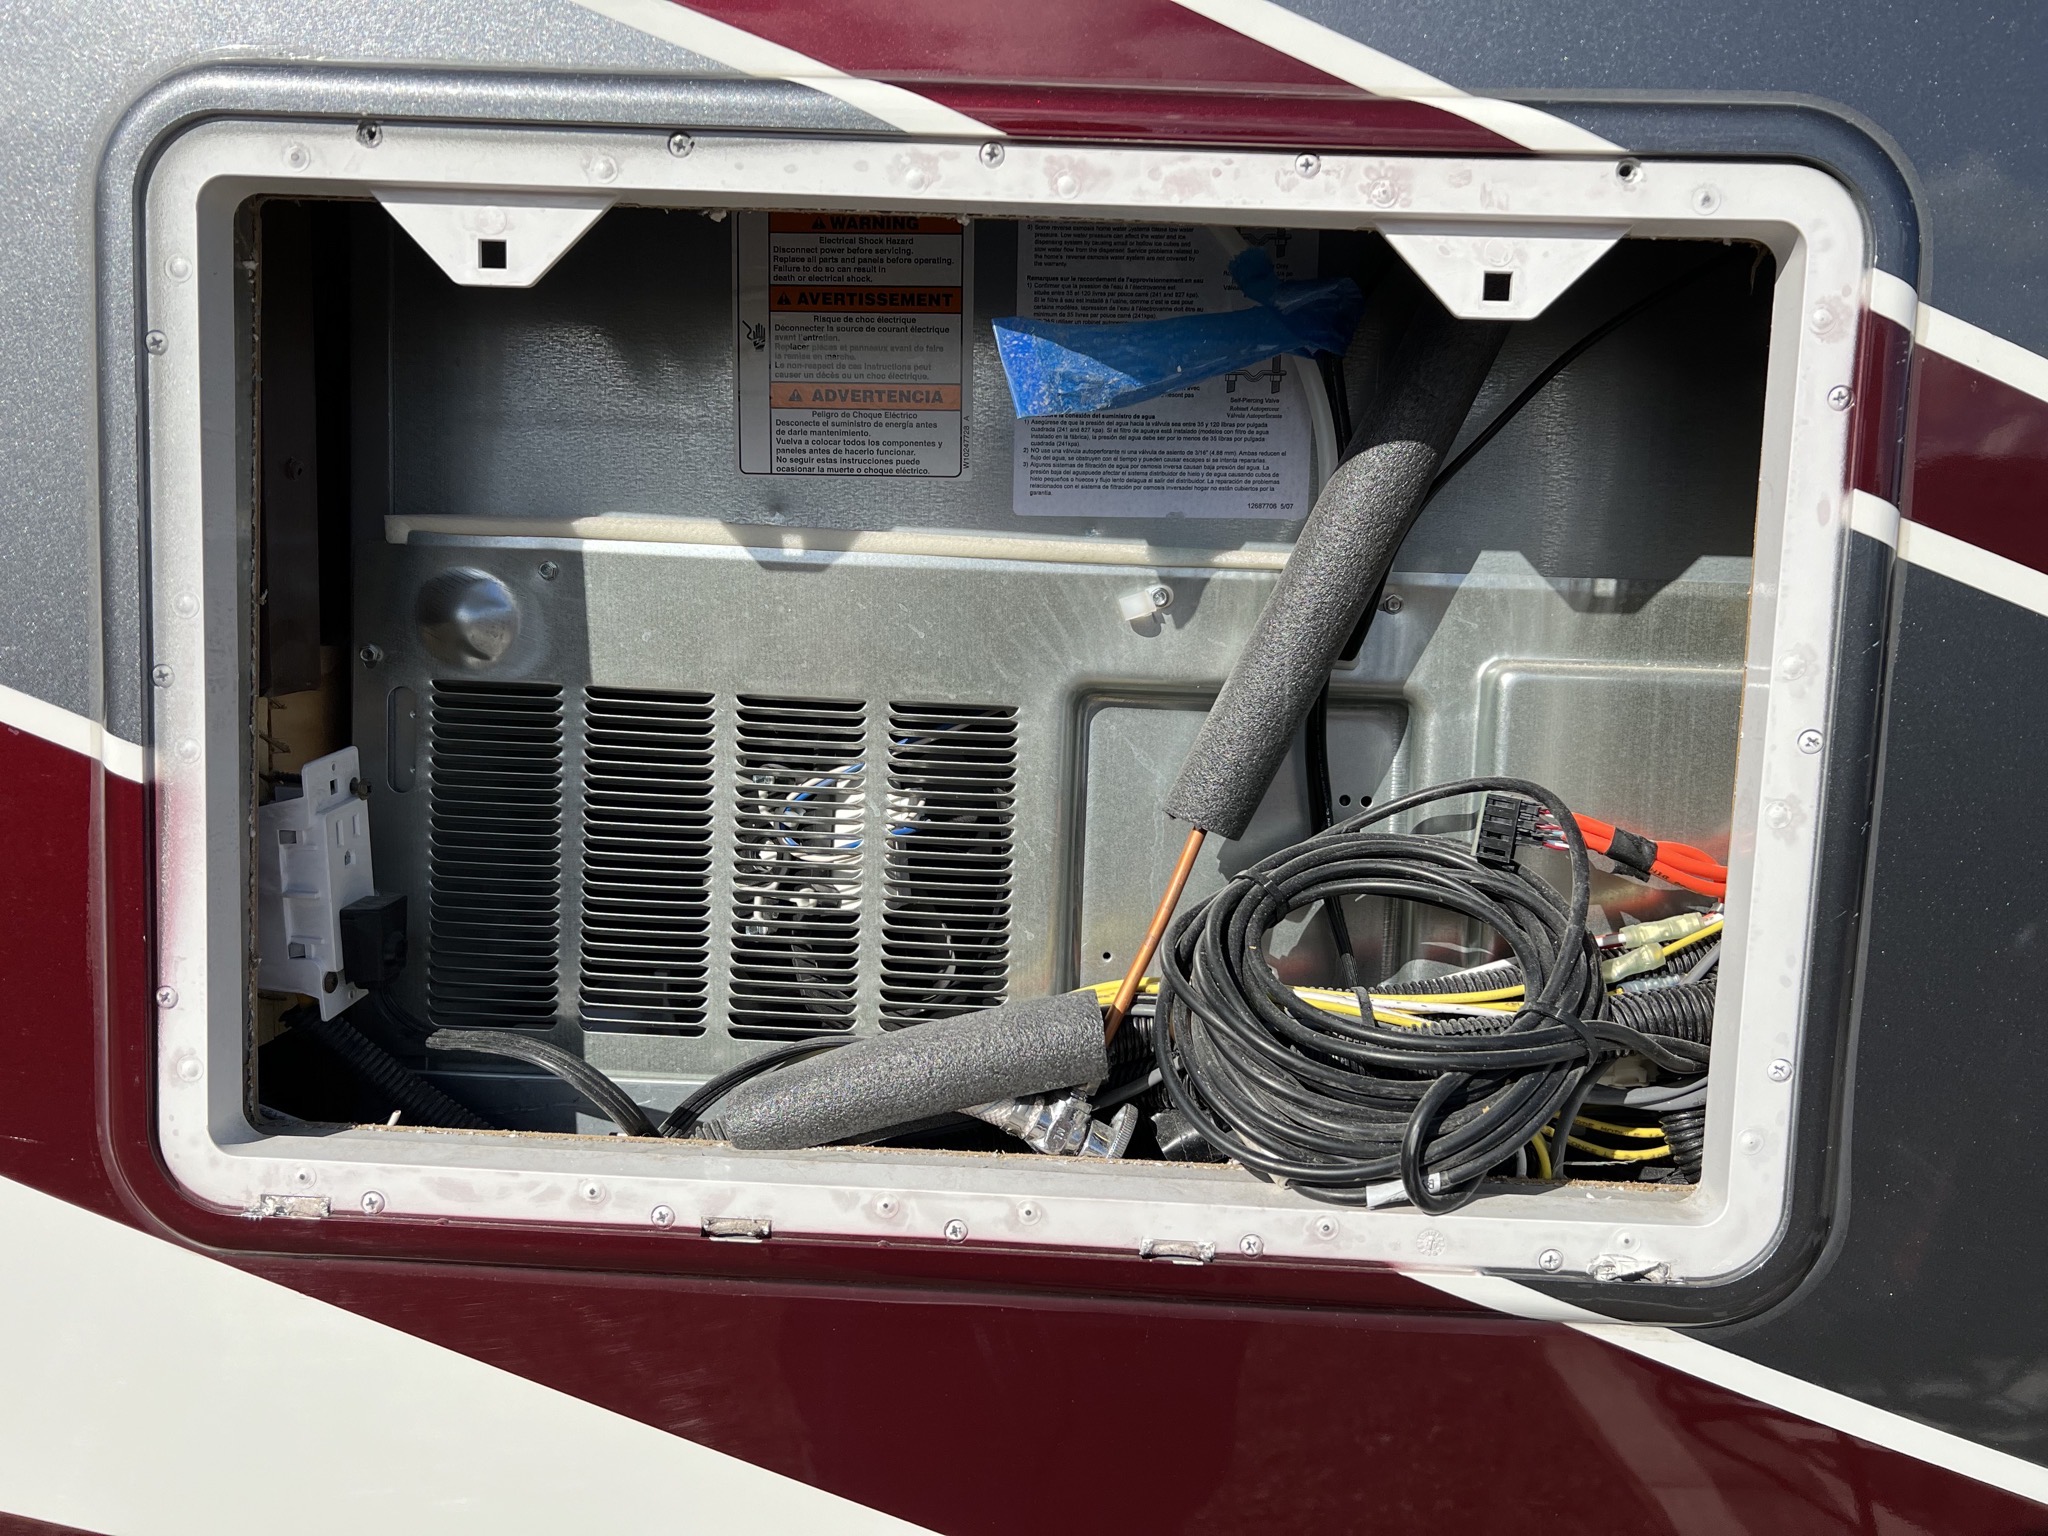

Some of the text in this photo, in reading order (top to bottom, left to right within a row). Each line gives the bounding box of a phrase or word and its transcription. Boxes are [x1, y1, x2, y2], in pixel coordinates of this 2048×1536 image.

[830, 217, 920, 230] WARNING
[773, 246, 818, 254] Disconnect
[818, 248, 845, 256] power
[873, 247, 914, 256] servicing.
[773, 256, 955, 266] Replace all parts and panels before operating.
[773, 265, 801, 273] Failure
[801, 265, 811, 273] to
[811, 265, 823, 273] do
[846, 275, 873, 283] shock.
[798, 293, 953, 307] AVERTISSEMENT
[813, 316, 841, 325] Risque
[854, 316, 875, 324] choc
[876, 316, 917, 326] électrique
[826, 325, 835, 333] la
[865, 325, 875, 333] de
[877, 325, 908, 333] courant
[909, 325, 950, 335] électrique
[775, 334, 797, 342] avant
[775, 343, 811, 353] Replacer
[839, 344, 848, 352] et
[889, 344, 912, 352] avant
[913, 344, 924, 352] de
[925, 344, 944, 352] faire
[824, 353, 856, 361] marche.
[775, 362, 785, 370] Le
[785, 362, 834, 372] non-respect
[835, 362, 846, 370] de
[864, 362, 912, 371] instructions
[913, 363, 932, 373] peut
[815, 372, 840, 380] décès
[865, 372, 887, 380] choc
[888, 372, 929, 382] électrique.
[812, 389, 944, 404] ADVERTENCIA
[812, 411, 918, 421] Peligro de Choque Eléctrico
[776, 419, 938, 430] Desconecte el suministro de energía antes
[809, 429, 871, 437] mantenimiento.
[776, 438, 802, 446] Vuelva
[811, 438, 841, 447] colocar
[842, 439, 867, 447] todos
[867, 439, 880, 447] los
[882, 440, 935, 448] componentes
[776, 447, 916, 457] paneles antes de hacerlo funcionar.
[789, 457, 814, 466] seguir
[816, 457, 837, 465] estas
[839, 457, 893, 465] instrucciones
[895, 457, 920, 467] puede
[776, 466, 816, 474] ocasionar
[816, 466, 826, 474] la
[825, 466, 855, 474] muerte
[862, 466, 894, 476] choque
